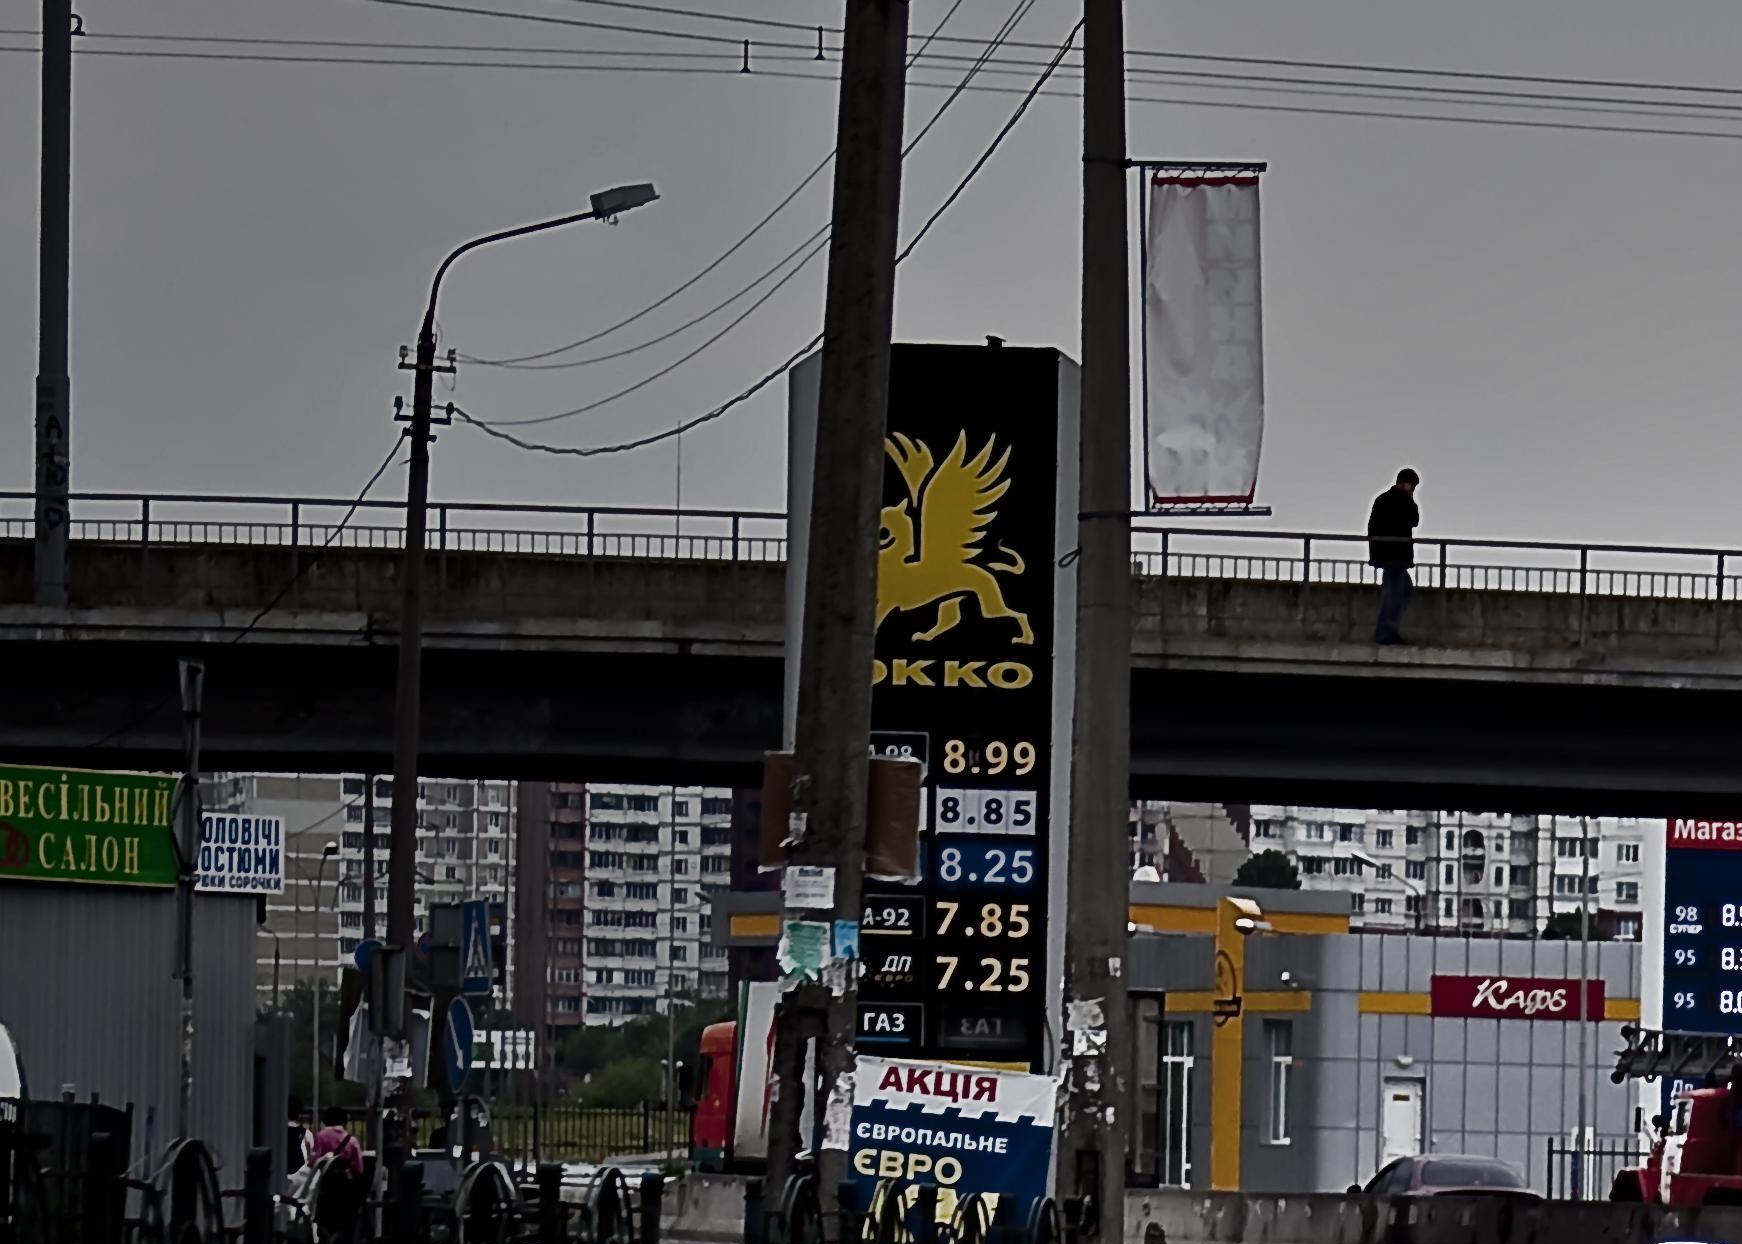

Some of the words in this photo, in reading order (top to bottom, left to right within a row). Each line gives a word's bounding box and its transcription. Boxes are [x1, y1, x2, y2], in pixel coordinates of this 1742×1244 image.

[943, 739, 1036, 776] 8.99
[940, 796, 1032, 826] 8.85
[201, 816, 280, 847] ОЛОВІЧІ
[38, 832, 140, 875] САЛОН
[197, 845, 280, 876] ОСТЮМИ
[939, 847, 1033, 883] 8.25
[228, 875, 282, 891] СОРОЧКИ
[862, 907, 911, 927] А-92
[936, 901, 1030, 938] 7.85
[1675, 905, 1698, 922] 98
[881, 955, 913, 973] ДП
[936, 956, 1030, 992] 7.25
[1674, 949, 1696, 966] 95
[1673, 992, 1695, 1009] 95
[863, 1012, 905, 1033] ГАЗ
[879, 1066, 999, 1104] АКЦІЯ
[856, 1122, 1009, 1155] ЄВРОПАЛЬНЕ
[853, 1148, 963, 1185] ЄВРО
